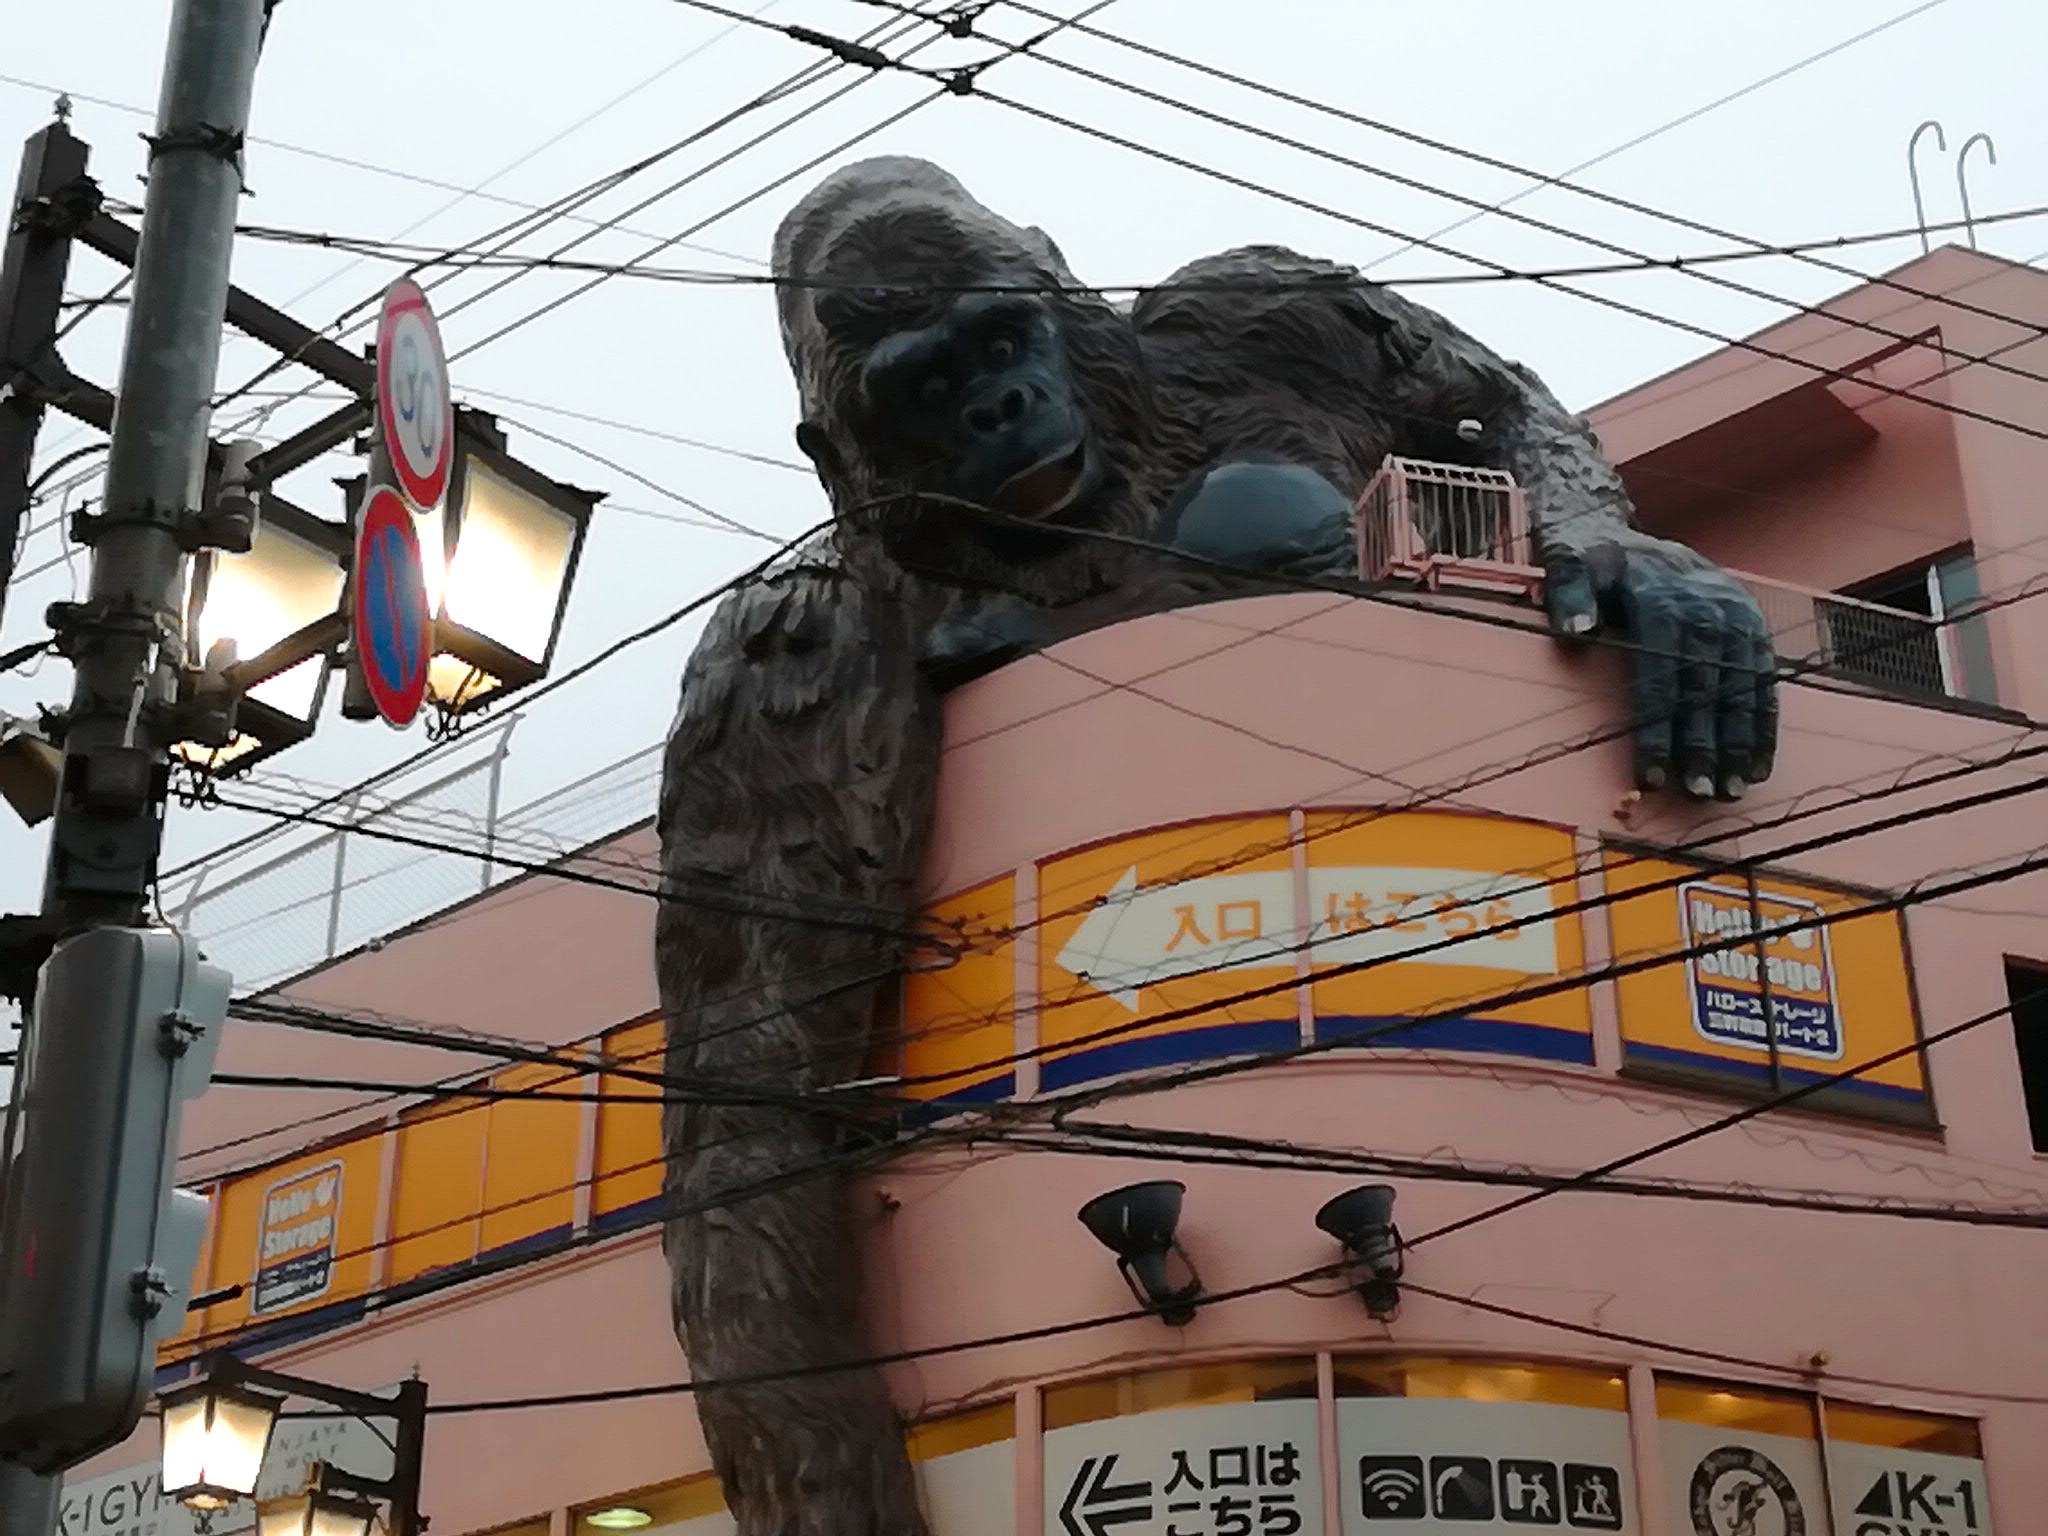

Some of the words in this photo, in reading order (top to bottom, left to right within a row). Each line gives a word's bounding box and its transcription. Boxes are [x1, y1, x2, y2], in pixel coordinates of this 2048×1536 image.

[1163, 1441, 1301, 1495] 入口は
[1895, 1470, 1977, 1529] K-1
